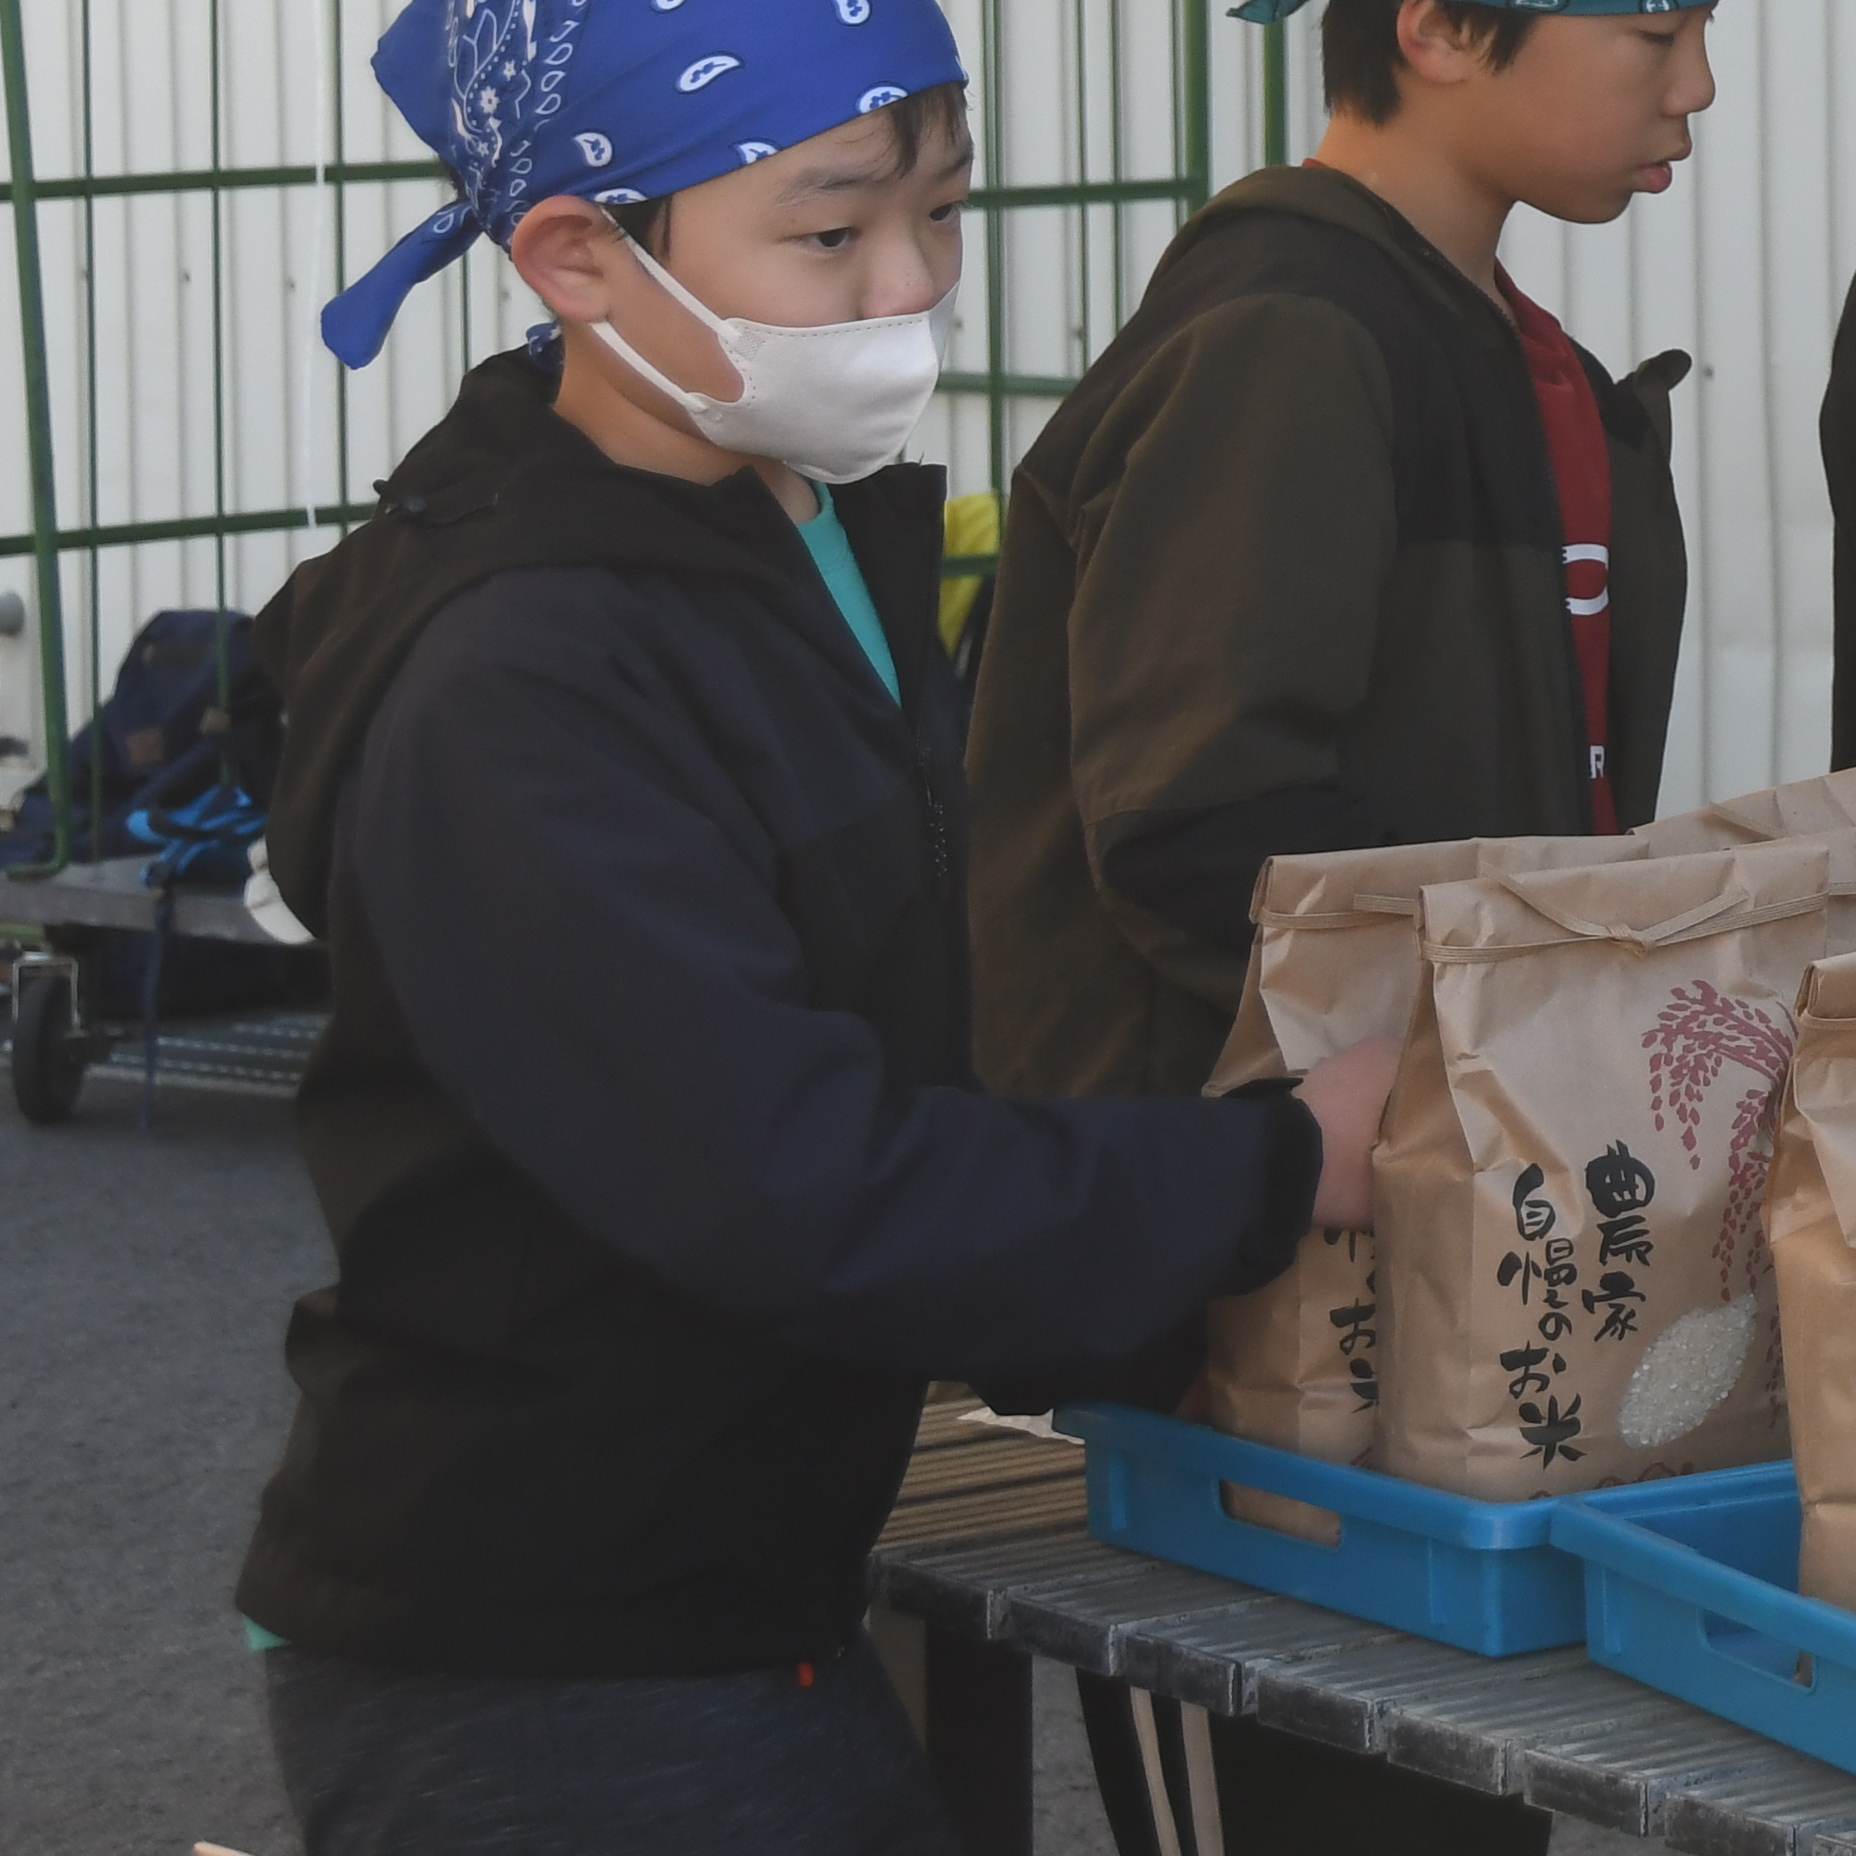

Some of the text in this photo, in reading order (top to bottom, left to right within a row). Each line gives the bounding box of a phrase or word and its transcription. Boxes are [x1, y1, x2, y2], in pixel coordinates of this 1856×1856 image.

[1498, 1163, 1586, 1470] 自慢のお米
[1581, 1139, 1655, 1343] 農家
